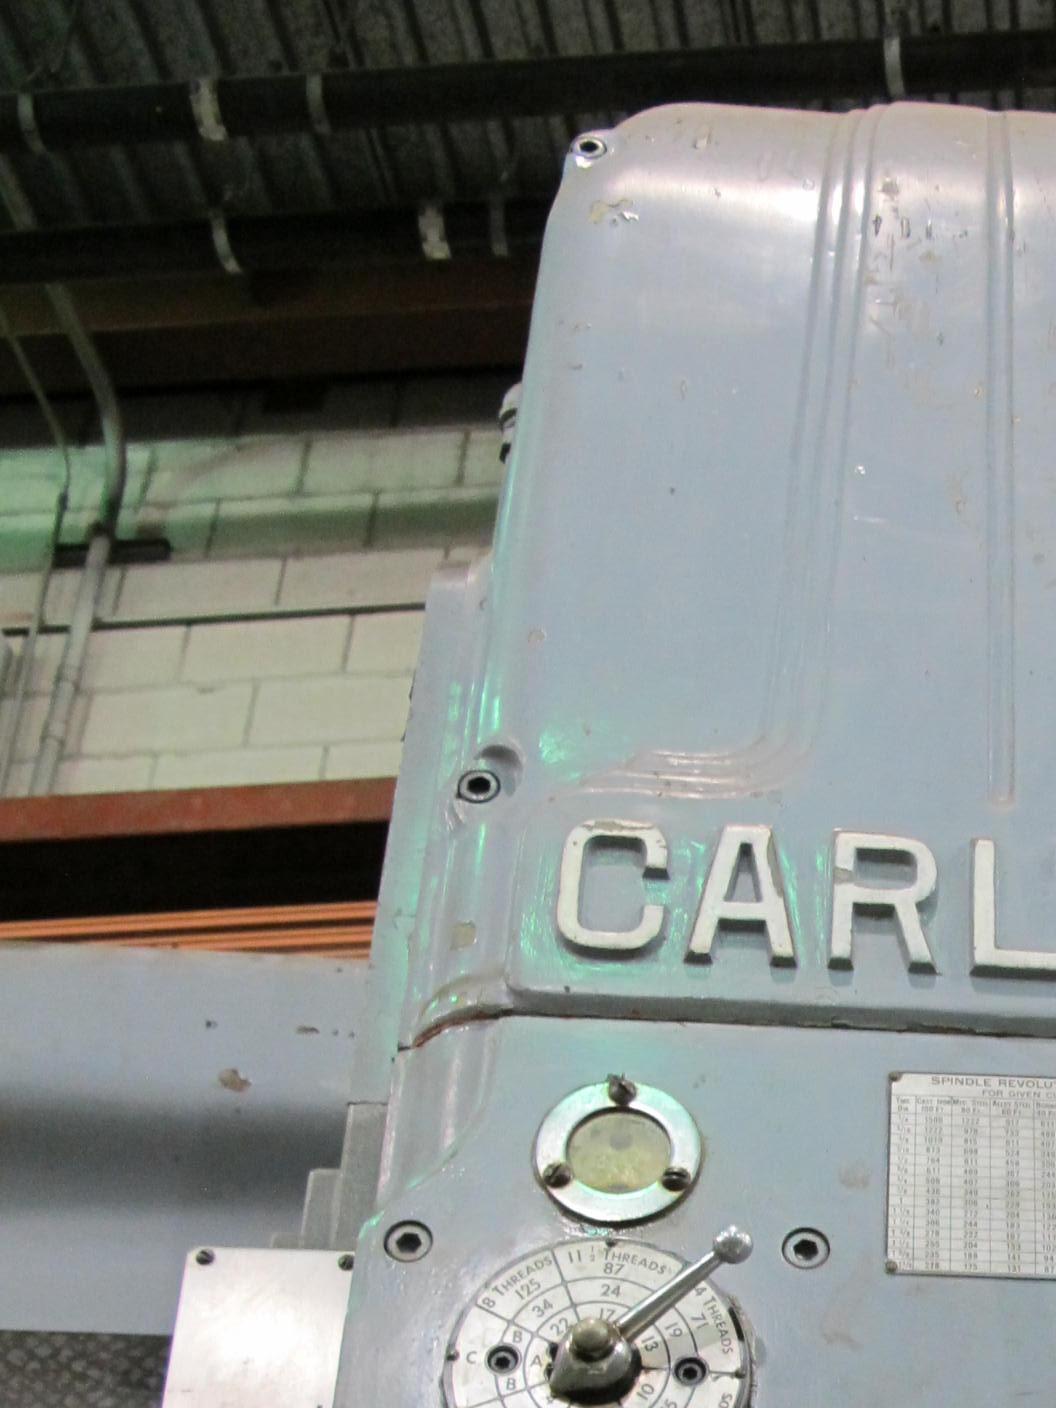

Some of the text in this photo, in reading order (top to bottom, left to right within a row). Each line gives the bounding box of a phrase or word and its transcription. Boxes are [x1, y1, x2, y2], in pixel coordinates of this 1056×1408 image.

[931, 1076, 992, 1088] SPINDLE
[982, 1089, 1004, 1097] FOR
[1008, 1090, 1041, 1098] GIVEN
[603, 1248, 668, 1275] THREADS
[603, 1263, 625, 1275] 87
[482, 1256, 552, 1308] 8 THREADS
[514, 1279, 541, 1300] 125
[601, 1284, 621, 1297] 24
[532, 1299, 553, 1318] 34
[691, 1313, 709, 1329] 71
[703, 1296, 734, 1355] THREADS
[513, 1331, 522, 1343] B
[664, 1322, 683, 1338] 19
[641, 1336, 659, 1352] 13
[466, 1351, 478, 1364] C
[530, 1355, 543, 1367] A
[505, 1378, 517, 1391] B
[636, 1383, 655, 1401] 10
